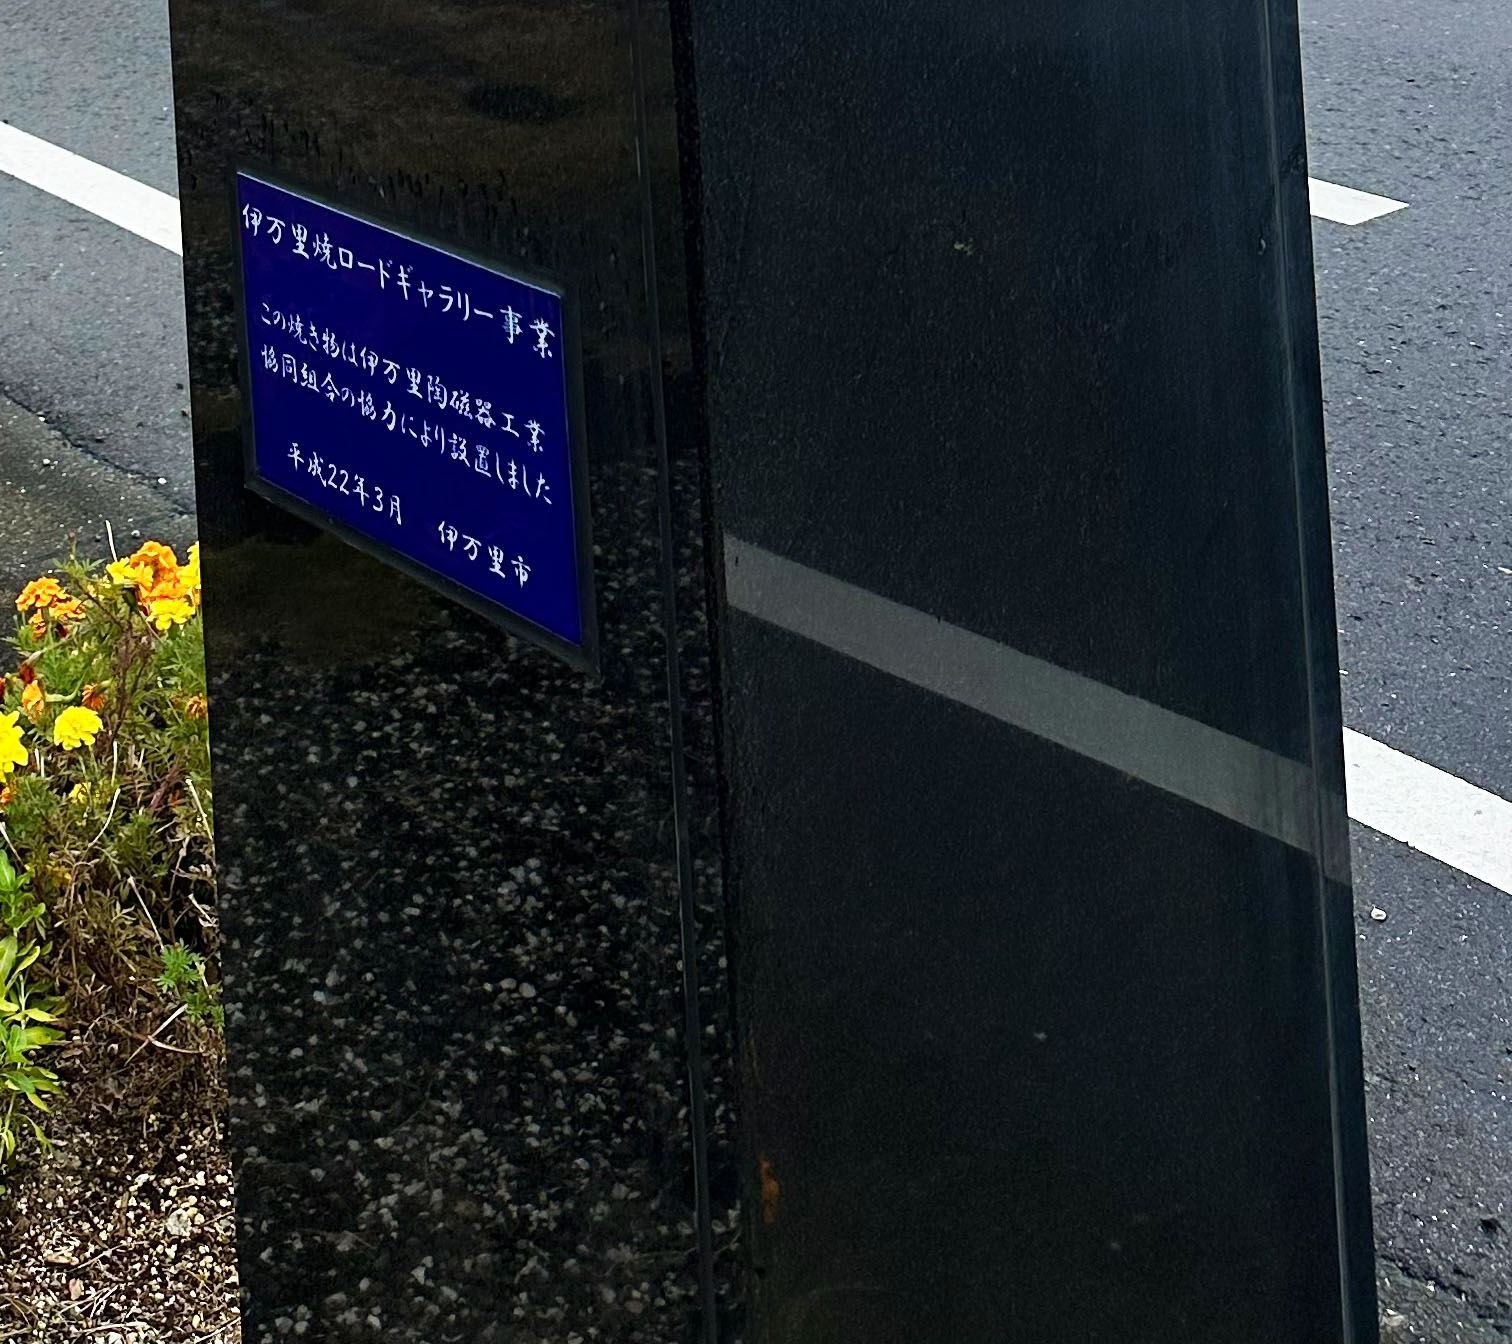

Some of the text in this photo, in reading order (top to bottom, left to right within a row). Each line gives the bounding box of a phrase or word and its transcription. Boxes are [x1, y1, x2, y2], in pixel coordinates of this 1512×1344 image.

[242, 203, 555, 359] 伊万里焼ロードギャラリー事業
[260, 344, 554, 505] 協同組合の協力により設置しました
[261, 302, 546, 453] この焼き物は伊万里陶磁器工業
[288, 442, 532, 589] 平成22年3月 伊万里市
